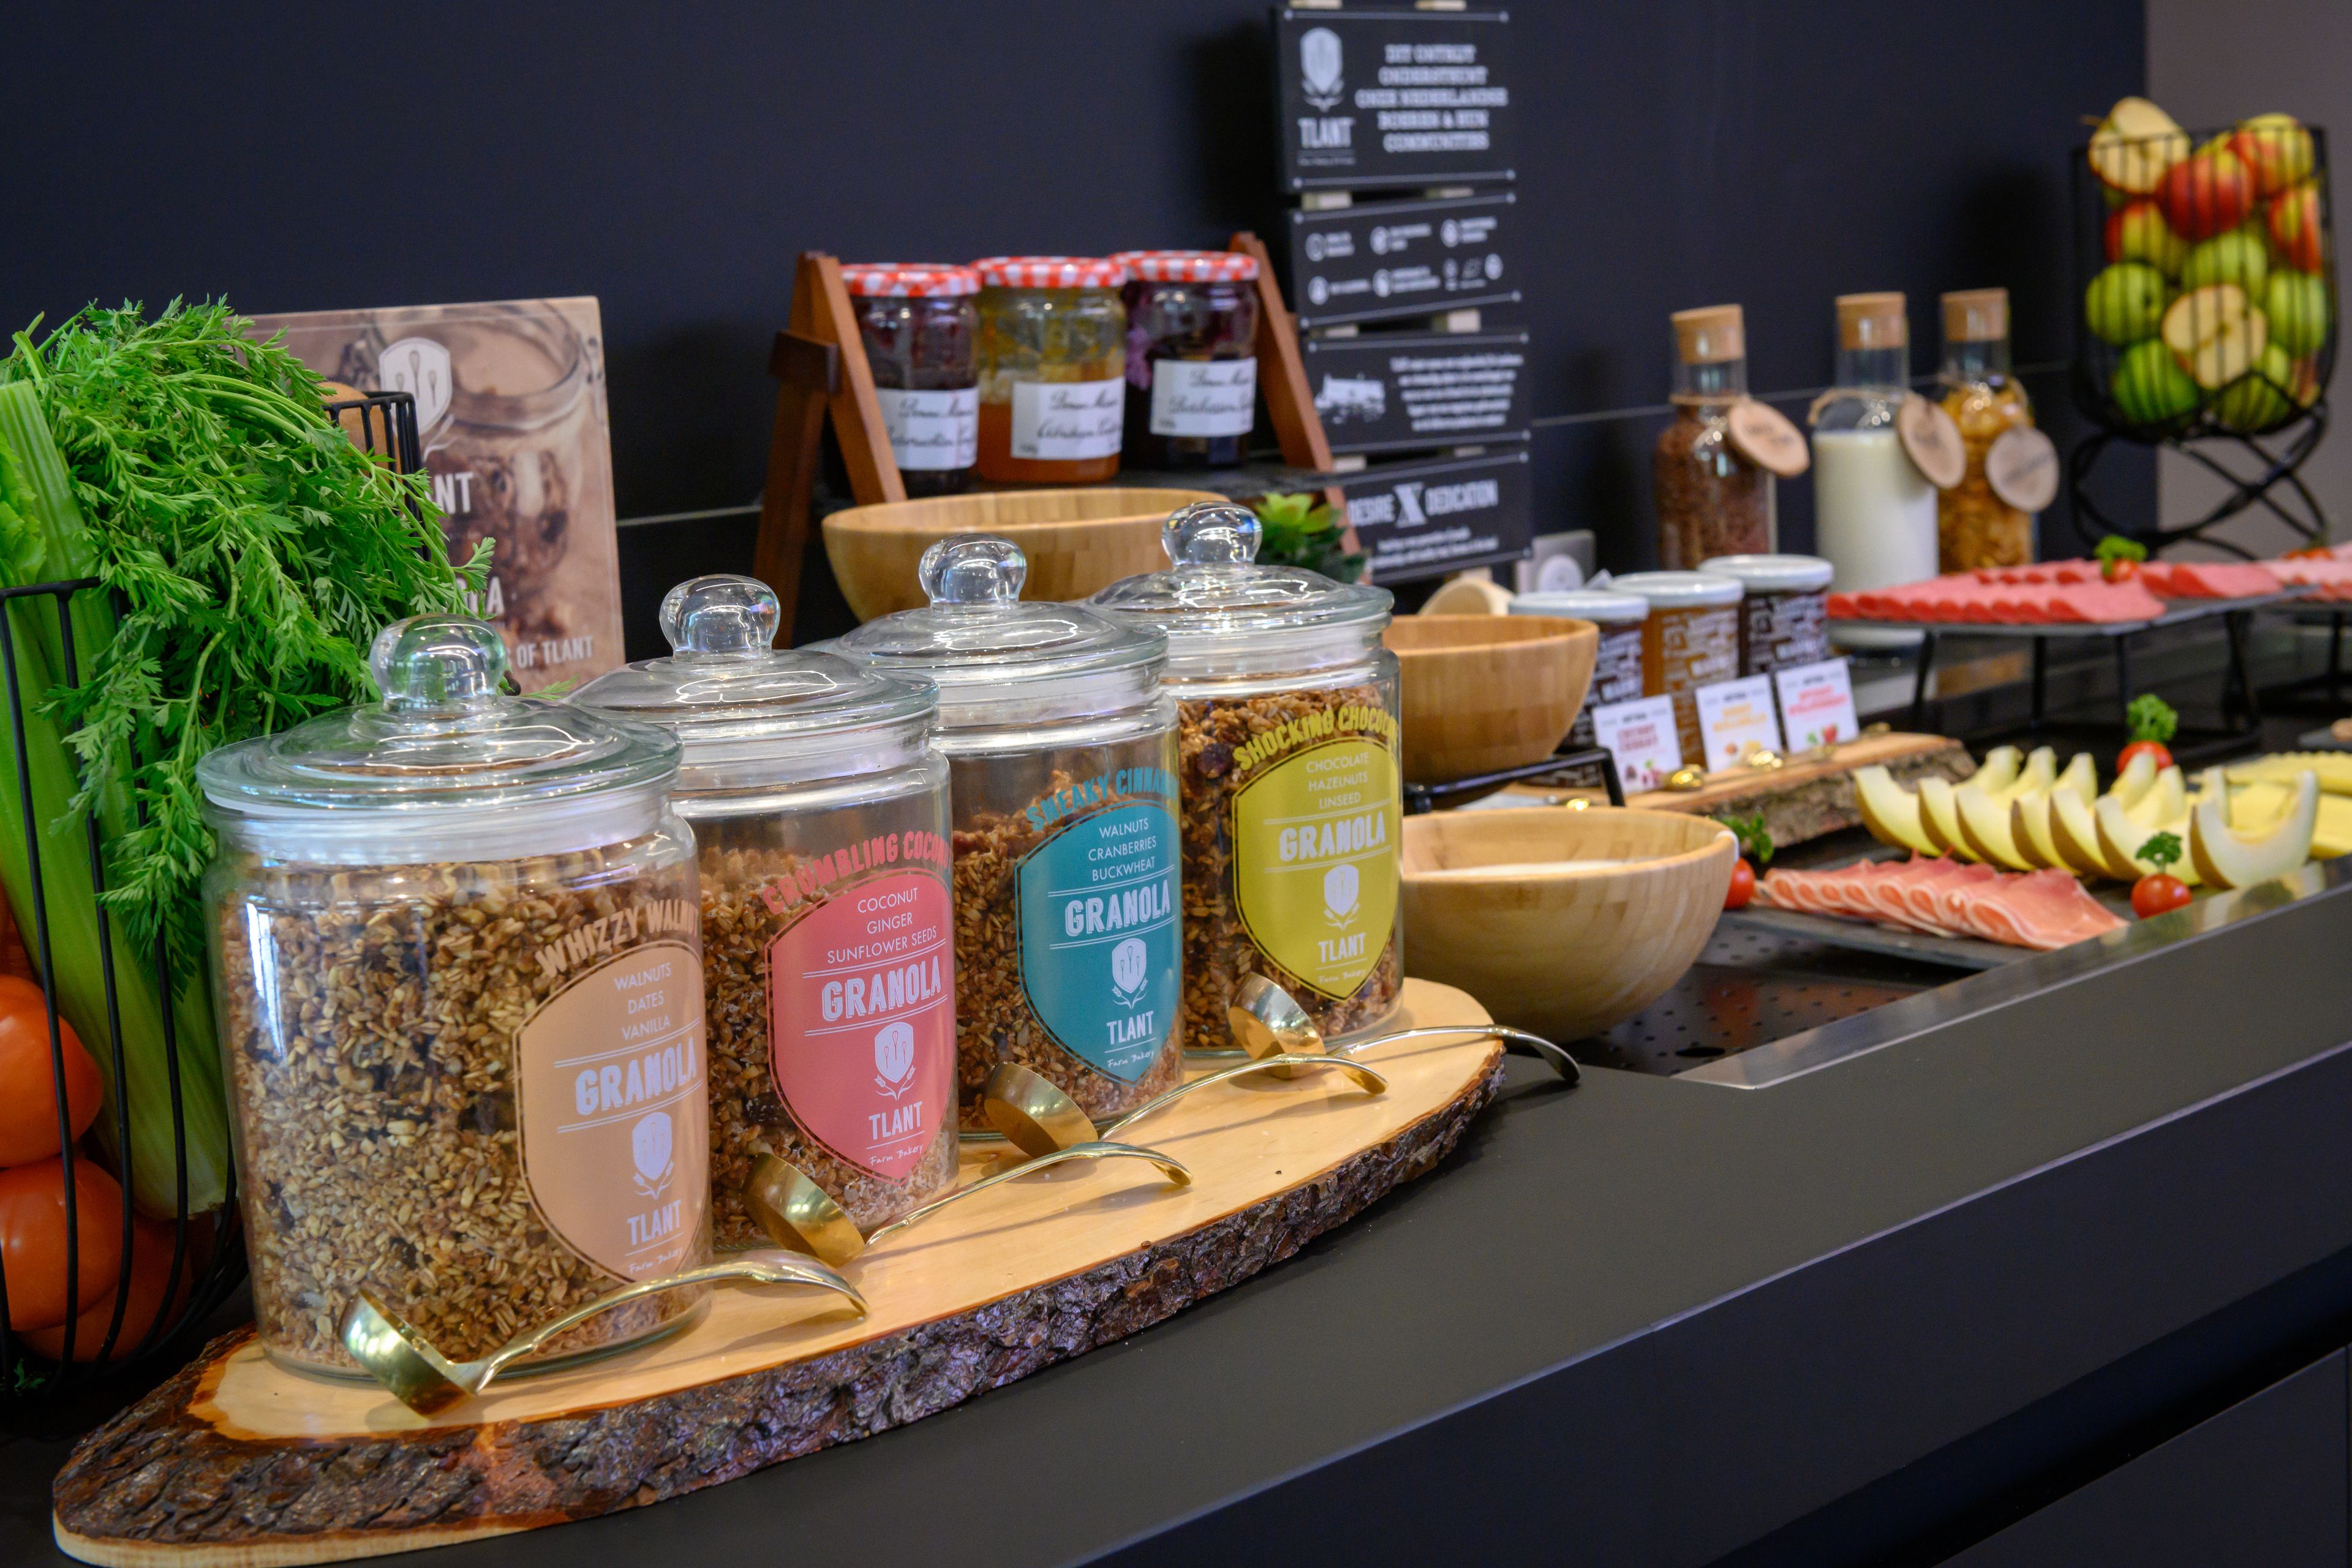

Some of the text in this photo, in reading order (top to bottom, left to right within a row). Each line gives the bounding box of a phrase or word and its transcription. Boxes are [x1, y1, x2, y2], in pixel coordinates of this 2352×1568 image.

[1297, 116, 1355, 148] TLANT
[516, 643, 537, 669] OF
[541, 635, 594, 665] TLANT
[1232, 709, 1335, 771] SHOCKING
[1306, 752, 1369, 774] CHOCOLATE
[1308, 771, 1368, 793] HAZELNUTS
[1026, 774, 1110, 832] SNEAKY
[1318, 791, 1361, 810] LINSEED
[1099, 818, 1149, 839] WALNUTS
[1279, 810, 1386, 862] GRANOLA
[1088, 835, 1157, 861] CRANBERRIES
[763, 832, 899, 915] CRUMBLING
[1092, 856, 1156, 881] BUCKWHEAT
[858, 887, 918, 914] COCONUT
[1065, 879, 1171, 937] GRANOLA
[867, 912, 913, 935] GINGER
[535, 906, 639, 978] WHIZZY
[827, 925, 937, 964] SUNFLOWER SEEDS
[1317, 932, 1366, 963] TLANT
[614, 962, 672, 991] WALNUTS
[821, 955, 942, 1022] GRANOLA
[627, 990, 665, 1014] DATES
[622, 1014, 671, 1041] VANILLA
[1106, 1011, 1154, 1045] TLANT
[1107, 1049, 1155, 1069] Farm Bakery
[575, 1035, 697, 1116] GRANOLA
[868, 1101, 923, 1140] TLANT
[869, 1144, 924, 1166] Farm Bakery
[627, 1199, 682, 1245] TLANT
